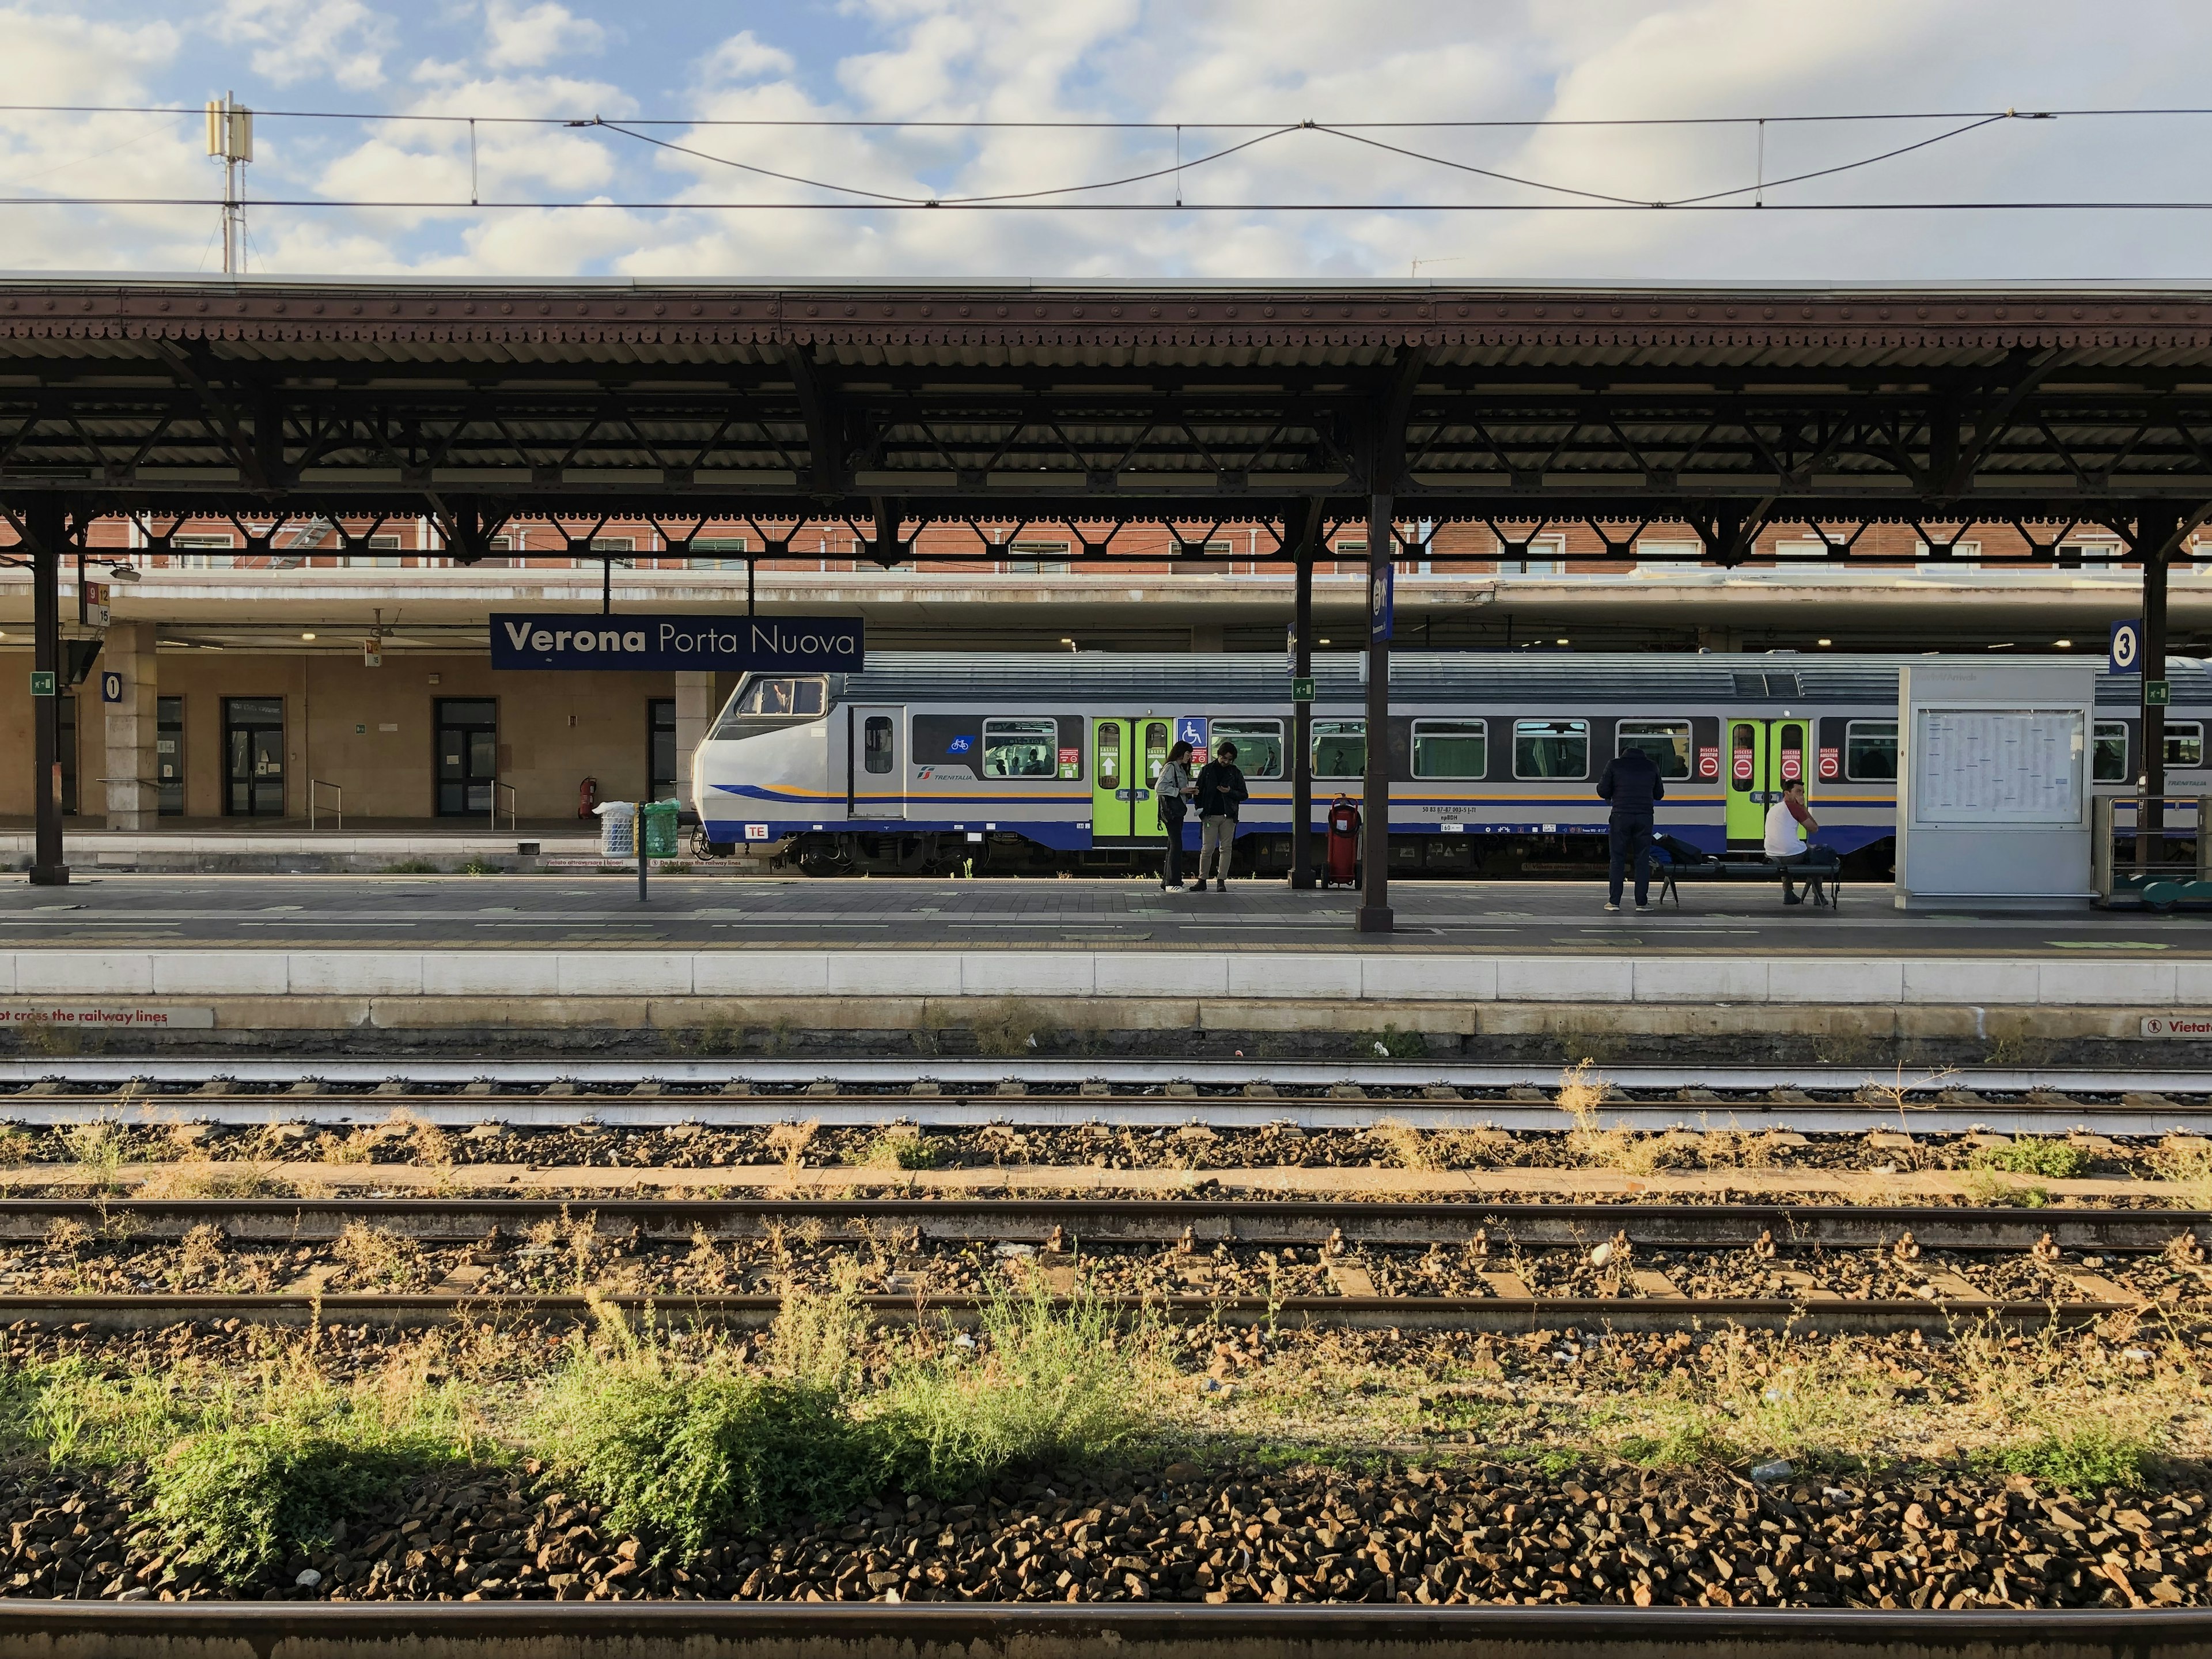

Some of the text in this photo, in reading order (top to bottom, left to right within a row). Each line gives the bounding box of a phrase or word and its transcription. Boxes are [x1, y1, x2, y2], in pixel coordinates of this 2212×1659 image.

[90, 587, 96, 599] 9
[100, 589, 108, 601] 12
[100, 611, 108, 622] 15
[504, 622, 854, 654] Verona Porta Nuova
[2119, 633, 2130, 660] 3
[111, 680, 115, 694] 1
[749, 827, 765, 836] TE
[52, 1009, 74, 1021] the
[79, 1010, 134, 1025] railway
[136, 1010, 168, 1022] lines
[2169, 1021, 2212, 1032] Vietat
